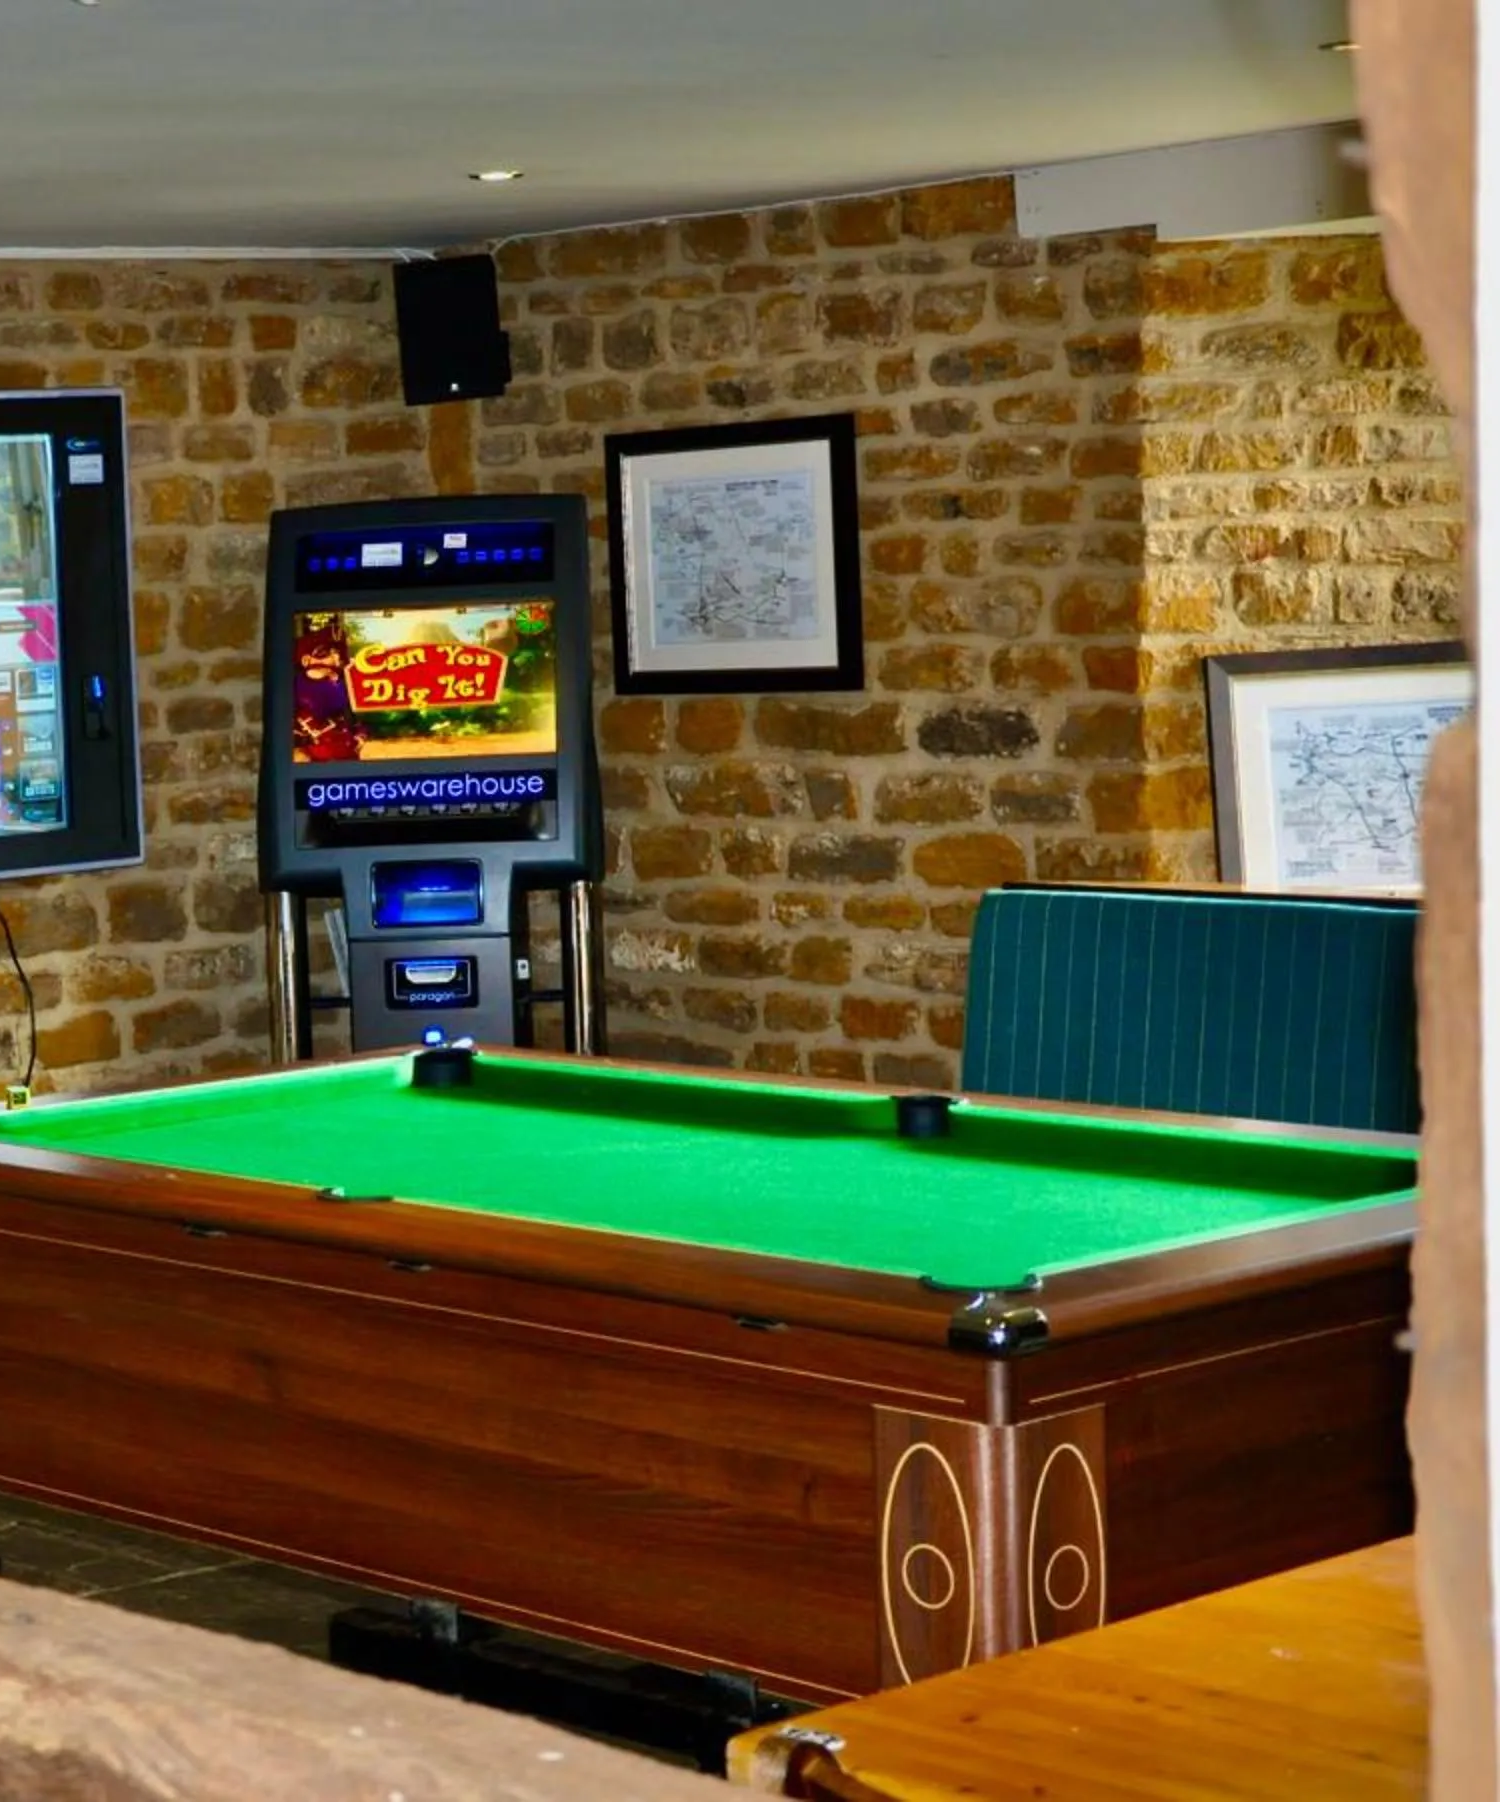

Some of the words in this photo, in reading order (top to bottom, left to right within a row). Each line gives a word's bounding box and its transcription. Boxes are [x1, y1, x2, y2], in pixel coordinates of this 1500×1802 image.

[355, 644, 427, 674] Can
[436, 645, 491, 666] You
[361, 679, 431, 710] Dig
[437, 672, 485, 700] It!
[308, 773, 544, 807] gameswarehouse
[409, 991, 455, 1003] paragon
